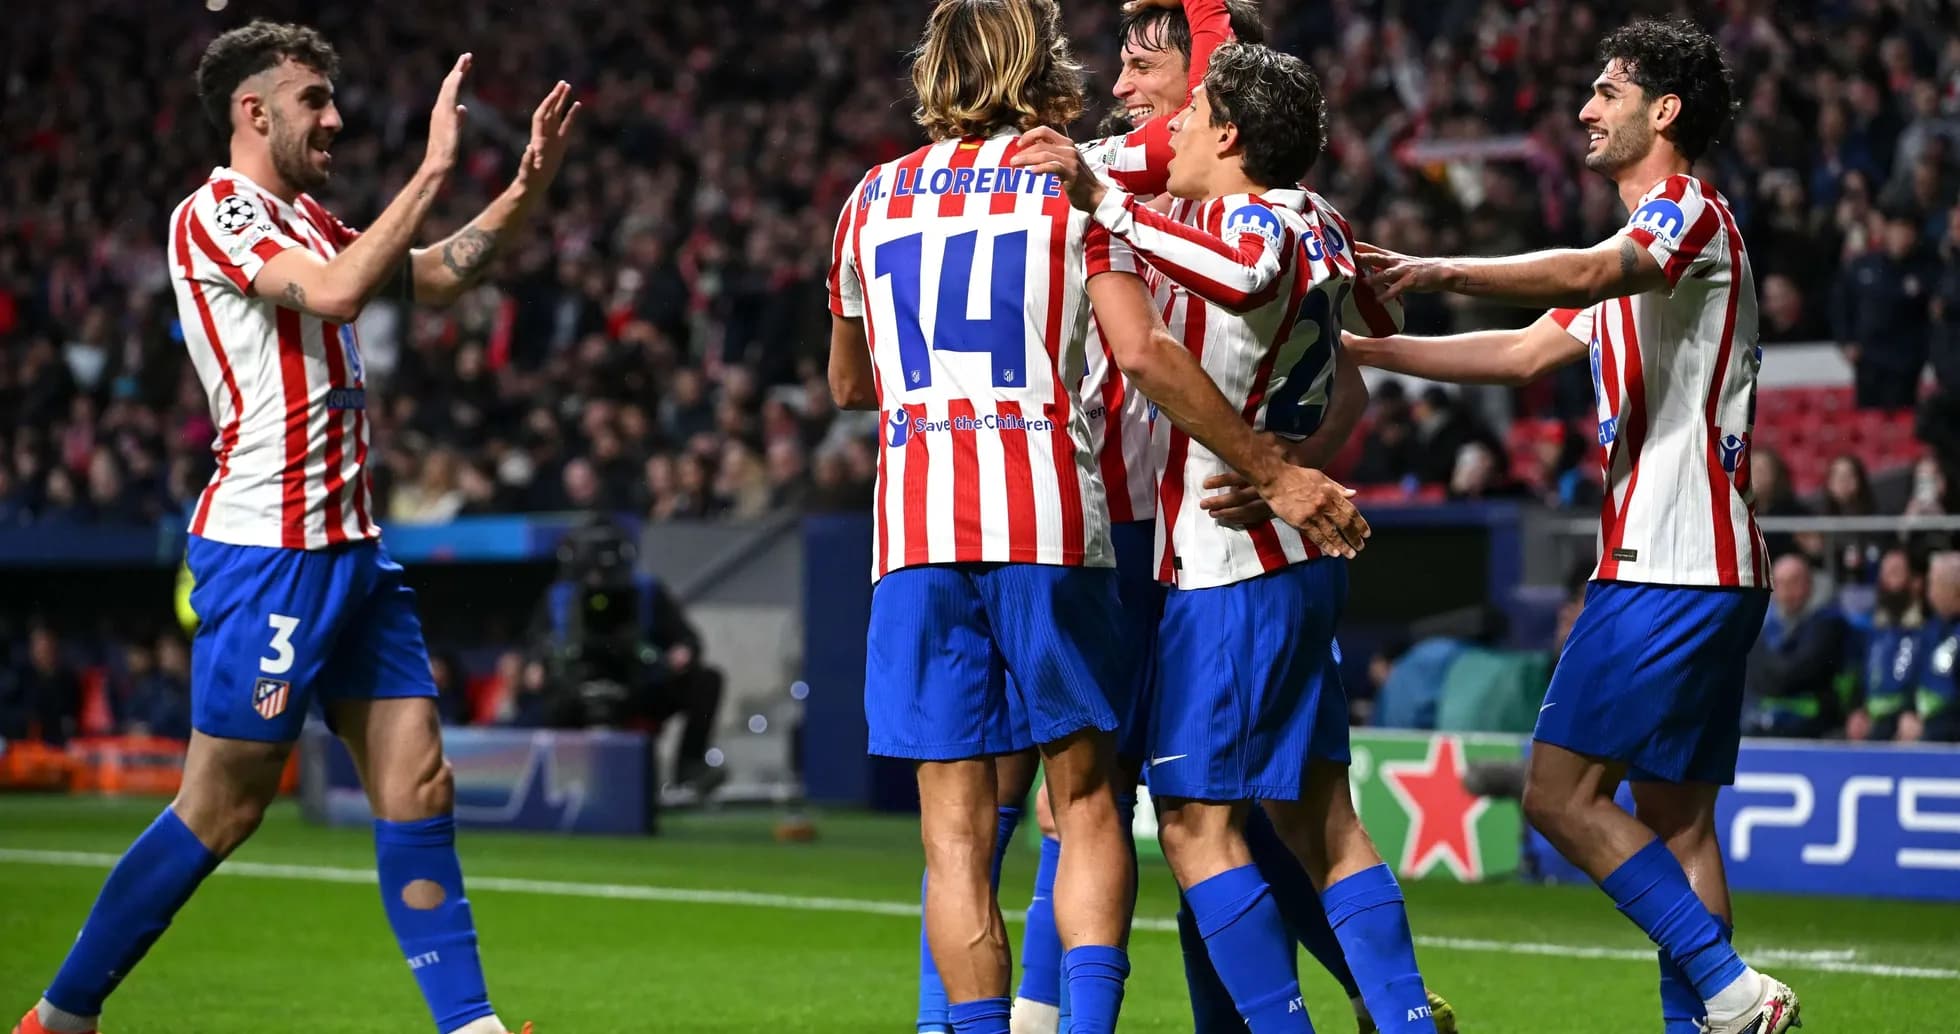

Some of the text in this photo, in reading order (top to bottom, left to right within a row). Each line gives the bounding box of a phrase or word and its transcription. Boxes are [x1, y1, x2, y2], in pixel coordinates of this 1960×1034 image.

[862, 168, 1060, 209] M. LLORENTE
[875, 229, 1028, 392] 14
[914, 413, 1055, 433] Save the Children
[259, 612, 300, 675] 3
[1730, 772, 1960, 871] PS5
